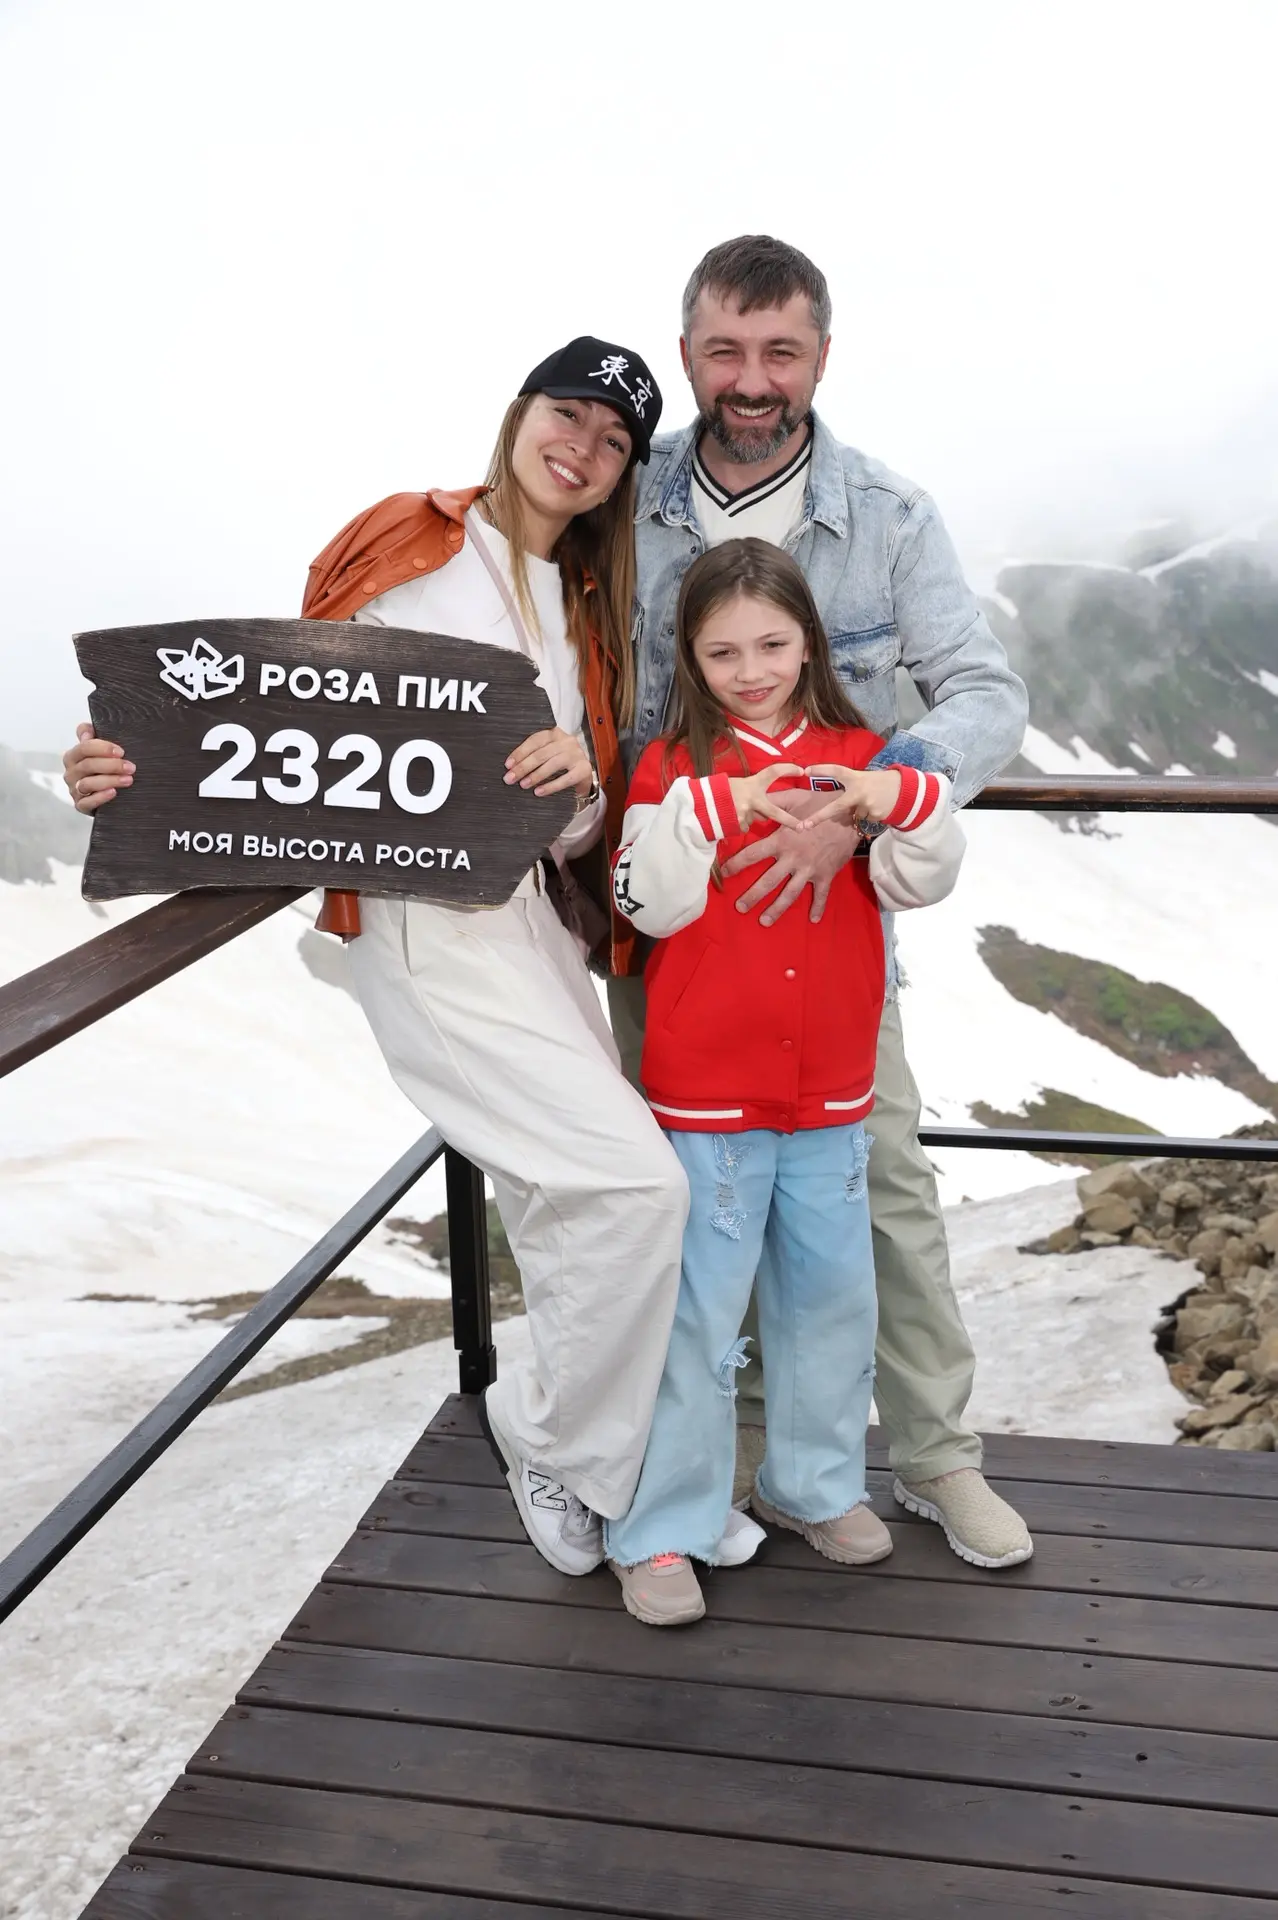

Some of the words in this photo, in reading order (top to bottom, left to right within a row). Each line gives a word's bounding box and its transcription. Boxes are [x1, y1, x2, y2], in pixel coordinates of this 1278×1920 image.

[587, 354, 654, 419] 東京
[258, 662, 381, 705] РОЗА
[396, 674, 489, 714] ПИК
[198, 723, 453, 815] 2320
[168, 829, 233, 855] МОЯ
[242, 834, 365, 864] ВЫСОТА
[375, 843, 471, 871] РОСТА
[527, 1469, 567, 1512] N
